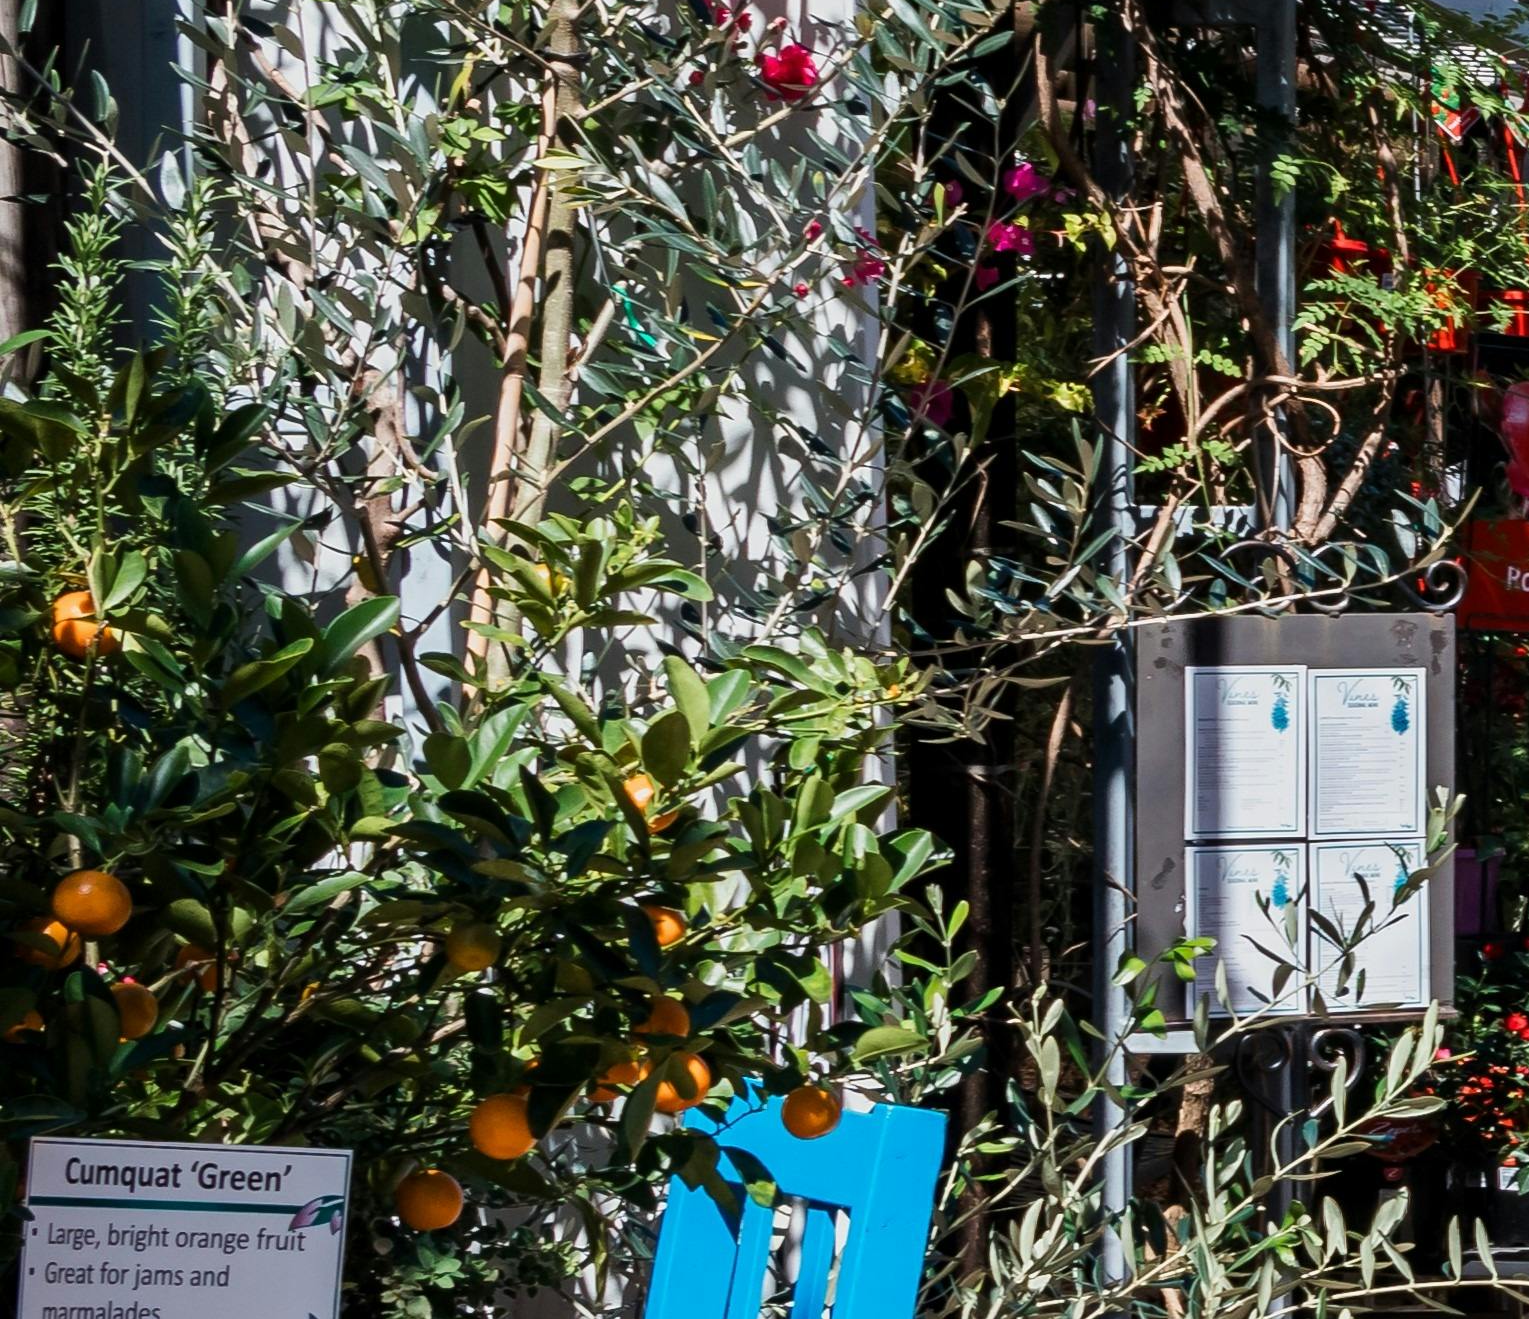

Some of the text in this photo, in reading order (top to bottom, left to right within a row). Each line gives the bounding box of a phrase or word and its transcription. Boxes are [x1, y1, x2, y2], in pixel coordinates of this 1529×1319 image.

[65, 1157, 293, 1193] Cumquat ‘Green’
[47, 1222, 307, 1254] Large, bright orange fruit
[44, 1261, 230, 1291] Great for jams and
